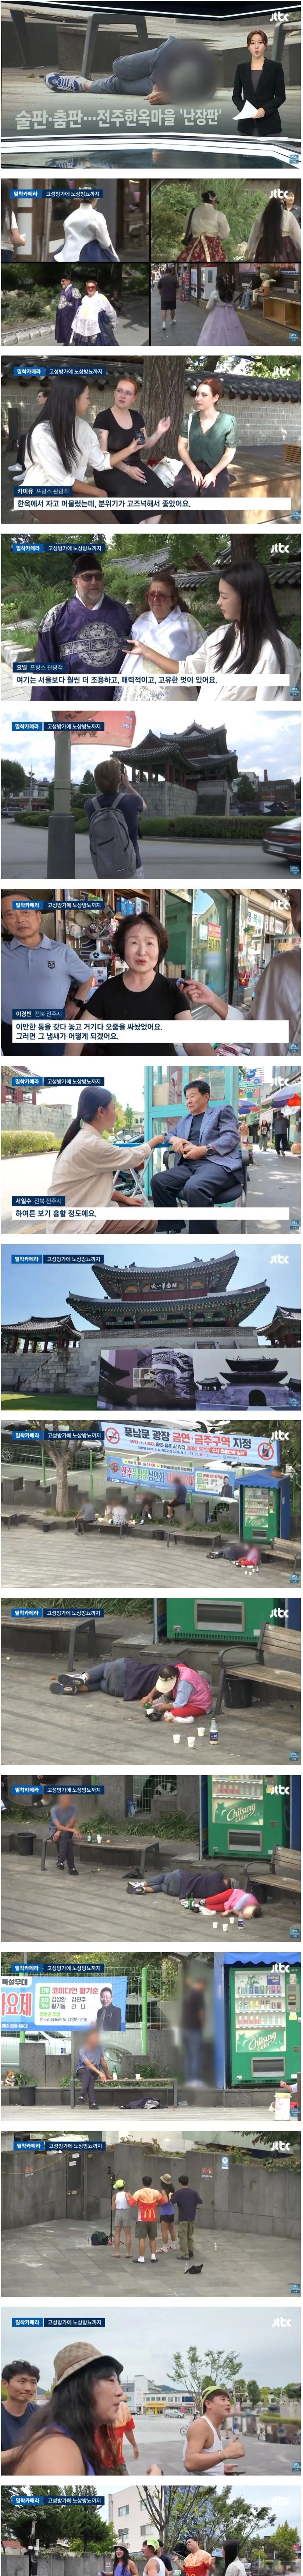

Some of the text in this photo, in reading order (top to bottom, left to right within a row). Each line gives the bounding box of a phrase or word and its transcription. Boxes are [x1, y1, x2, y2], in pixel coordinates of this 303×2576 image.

[124, 1427, 251, 1449] 풍남문 광장 금연·금주구역 지정
[227, 1803, 256, 1821] Chilsung
[235, 1812, 251, 1823] Cider
[248, 2032, 276, 2050] Chilsung
[257, 2040, 272, 2051] Cider
